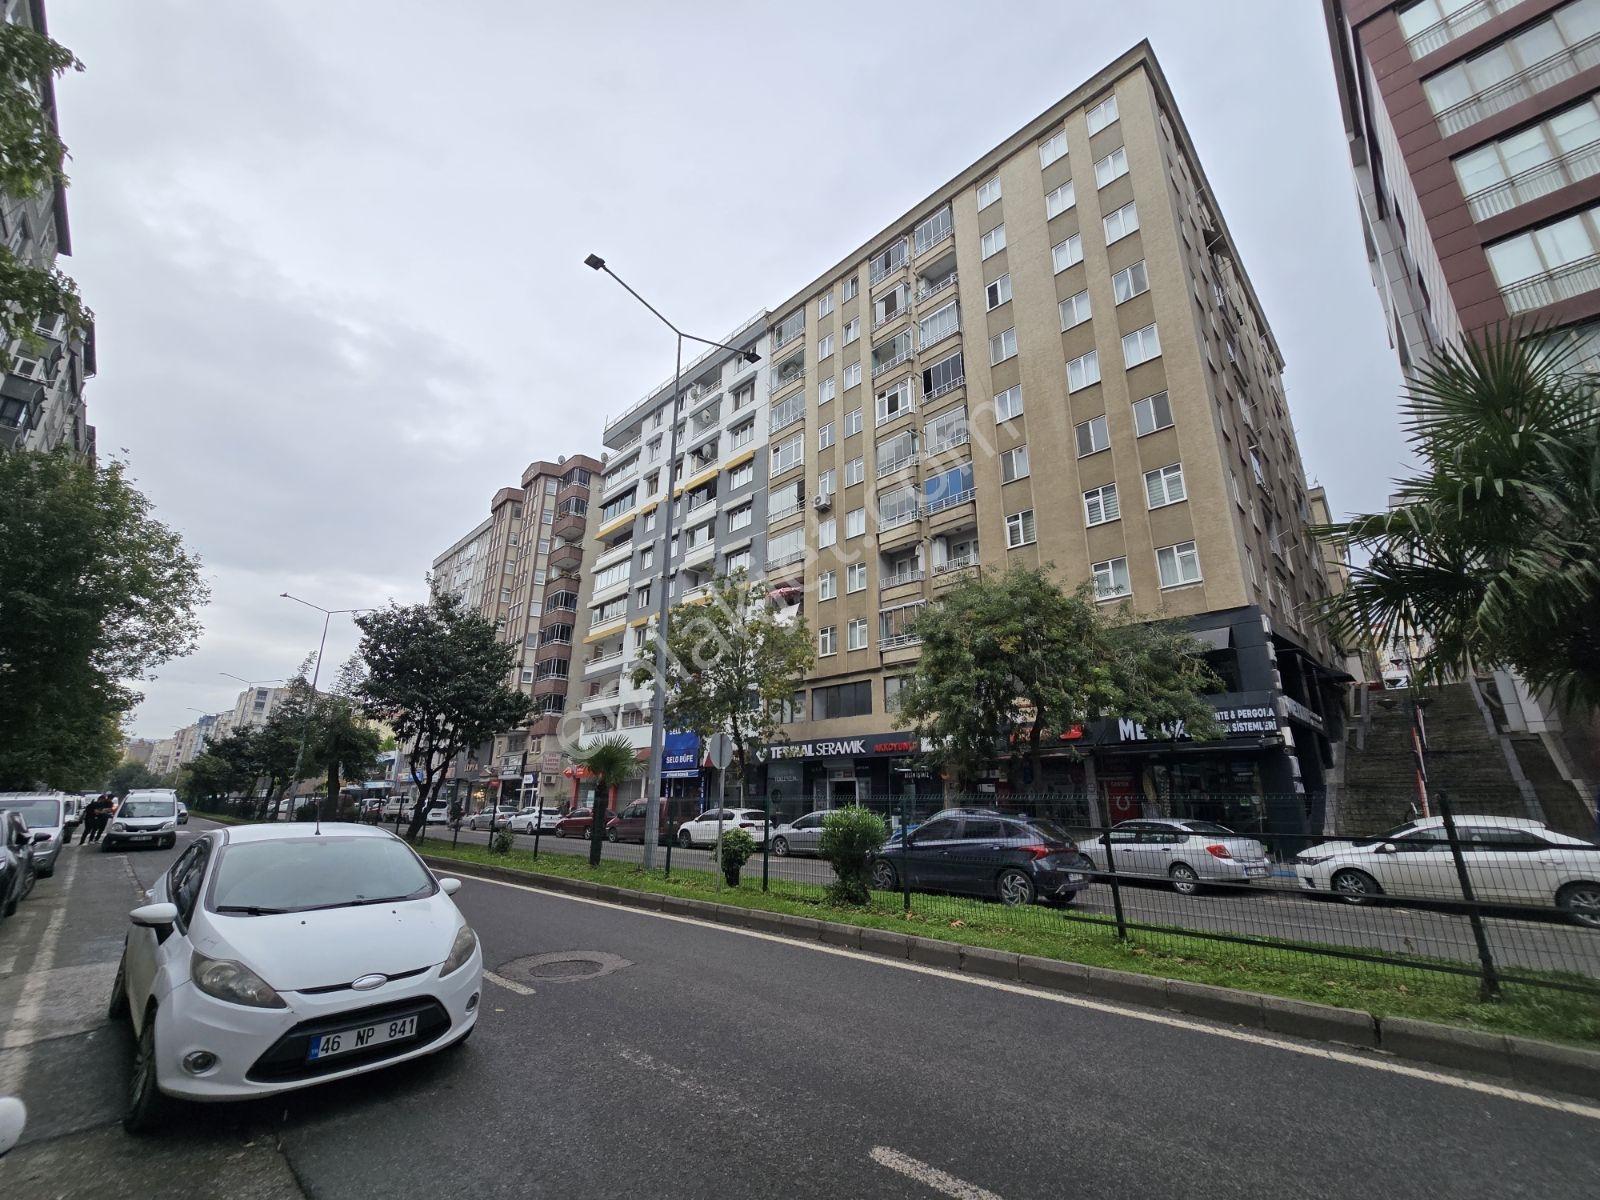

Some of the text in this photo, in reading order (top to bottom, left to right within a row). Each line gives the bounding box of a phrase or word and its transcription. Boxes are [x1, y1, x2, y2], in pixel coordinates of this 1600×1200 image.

[1237, 707, 1276, 719] PERGOLA
[321, 1035, 342, 1054] 46
[355, 1027, 375, 1047] NP
[389, 1018, 415, 1038] 841
